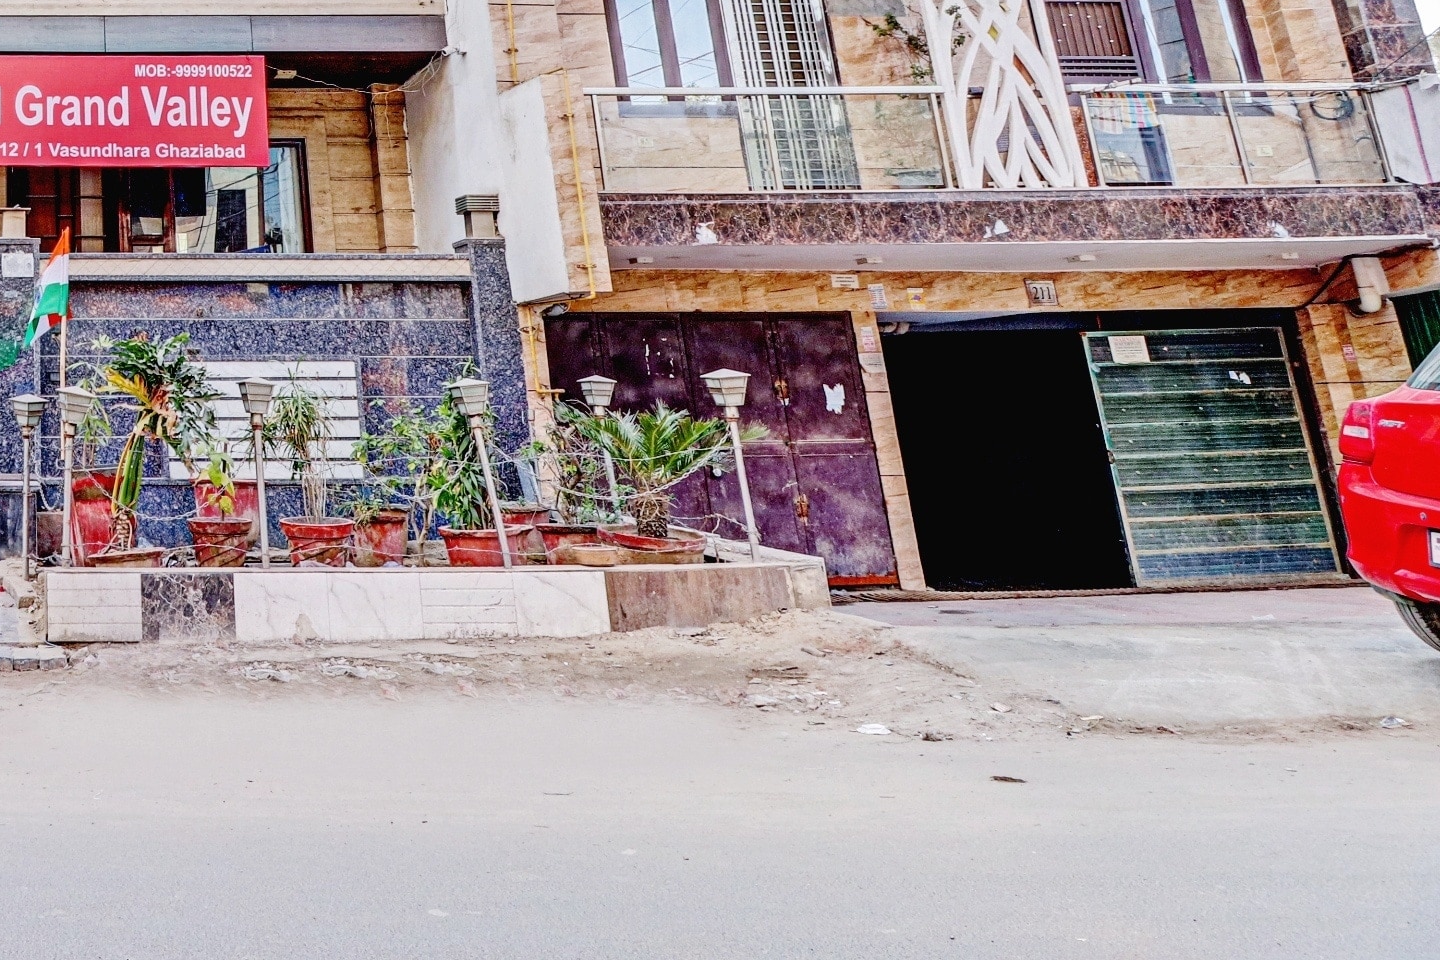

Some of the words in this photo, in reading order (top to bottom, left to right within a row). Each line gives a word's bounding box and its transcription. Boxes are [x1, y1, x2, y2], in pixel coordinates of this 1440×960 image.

[134, 65, 253, 78] MOB:-9999100522
[15, 85, 130, 127] Grand
[141, 85, 254, 138] Valley
[35, 143, 42, 157] 1
[48, 143, 150, 159] Vasundhara
[155, 143, 246, 159] Ghaziabad
[1032, 286, 1052, 300] 211
